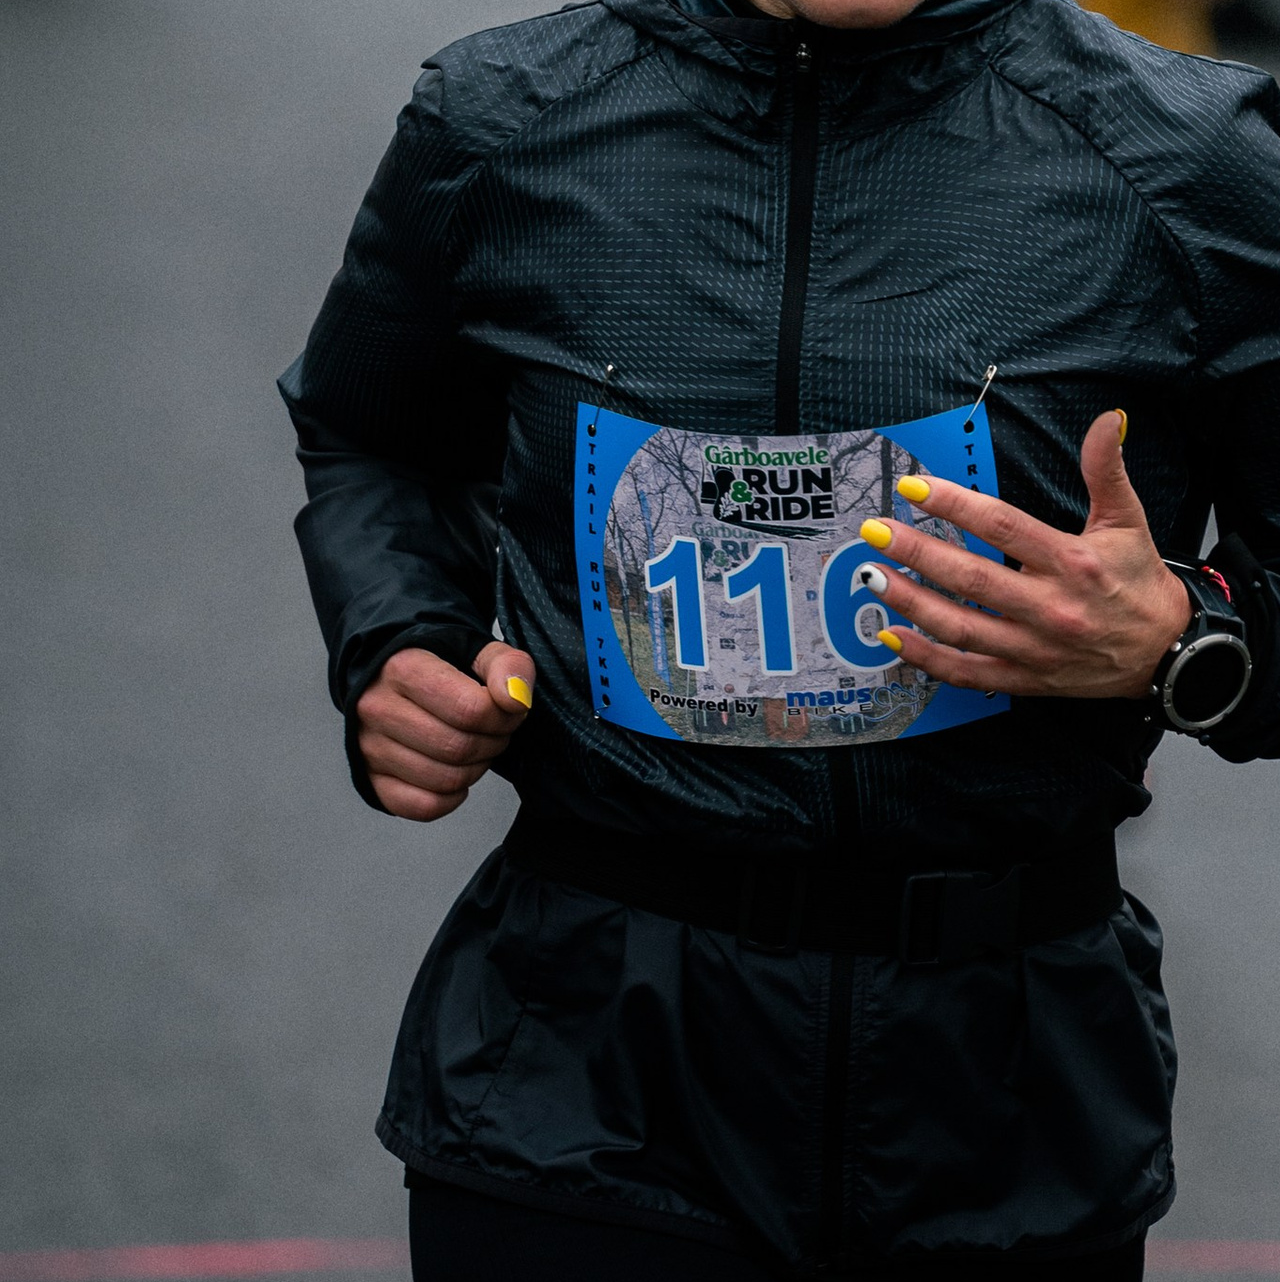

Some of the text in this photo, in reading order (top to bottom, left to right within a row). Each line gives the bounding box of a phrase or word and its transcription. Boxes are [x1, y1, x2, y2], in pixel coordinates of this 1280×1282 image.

[704, 445, 829, 467] Gârboavele
[964, 443, 980, 493] TRA
[730, 480, 753, 503] &
[742, 467, 833, 495] RUN
[745, 494, 836, 521] RIDE
[586, 442, 610, 689] TRAIL RUN 7KM
[645, 535, 914, 675] 116
[650, 688, 758, 717] Powered by
[786, 687, 872, 707] maus
[787, 704, 873, 716] BIKE
